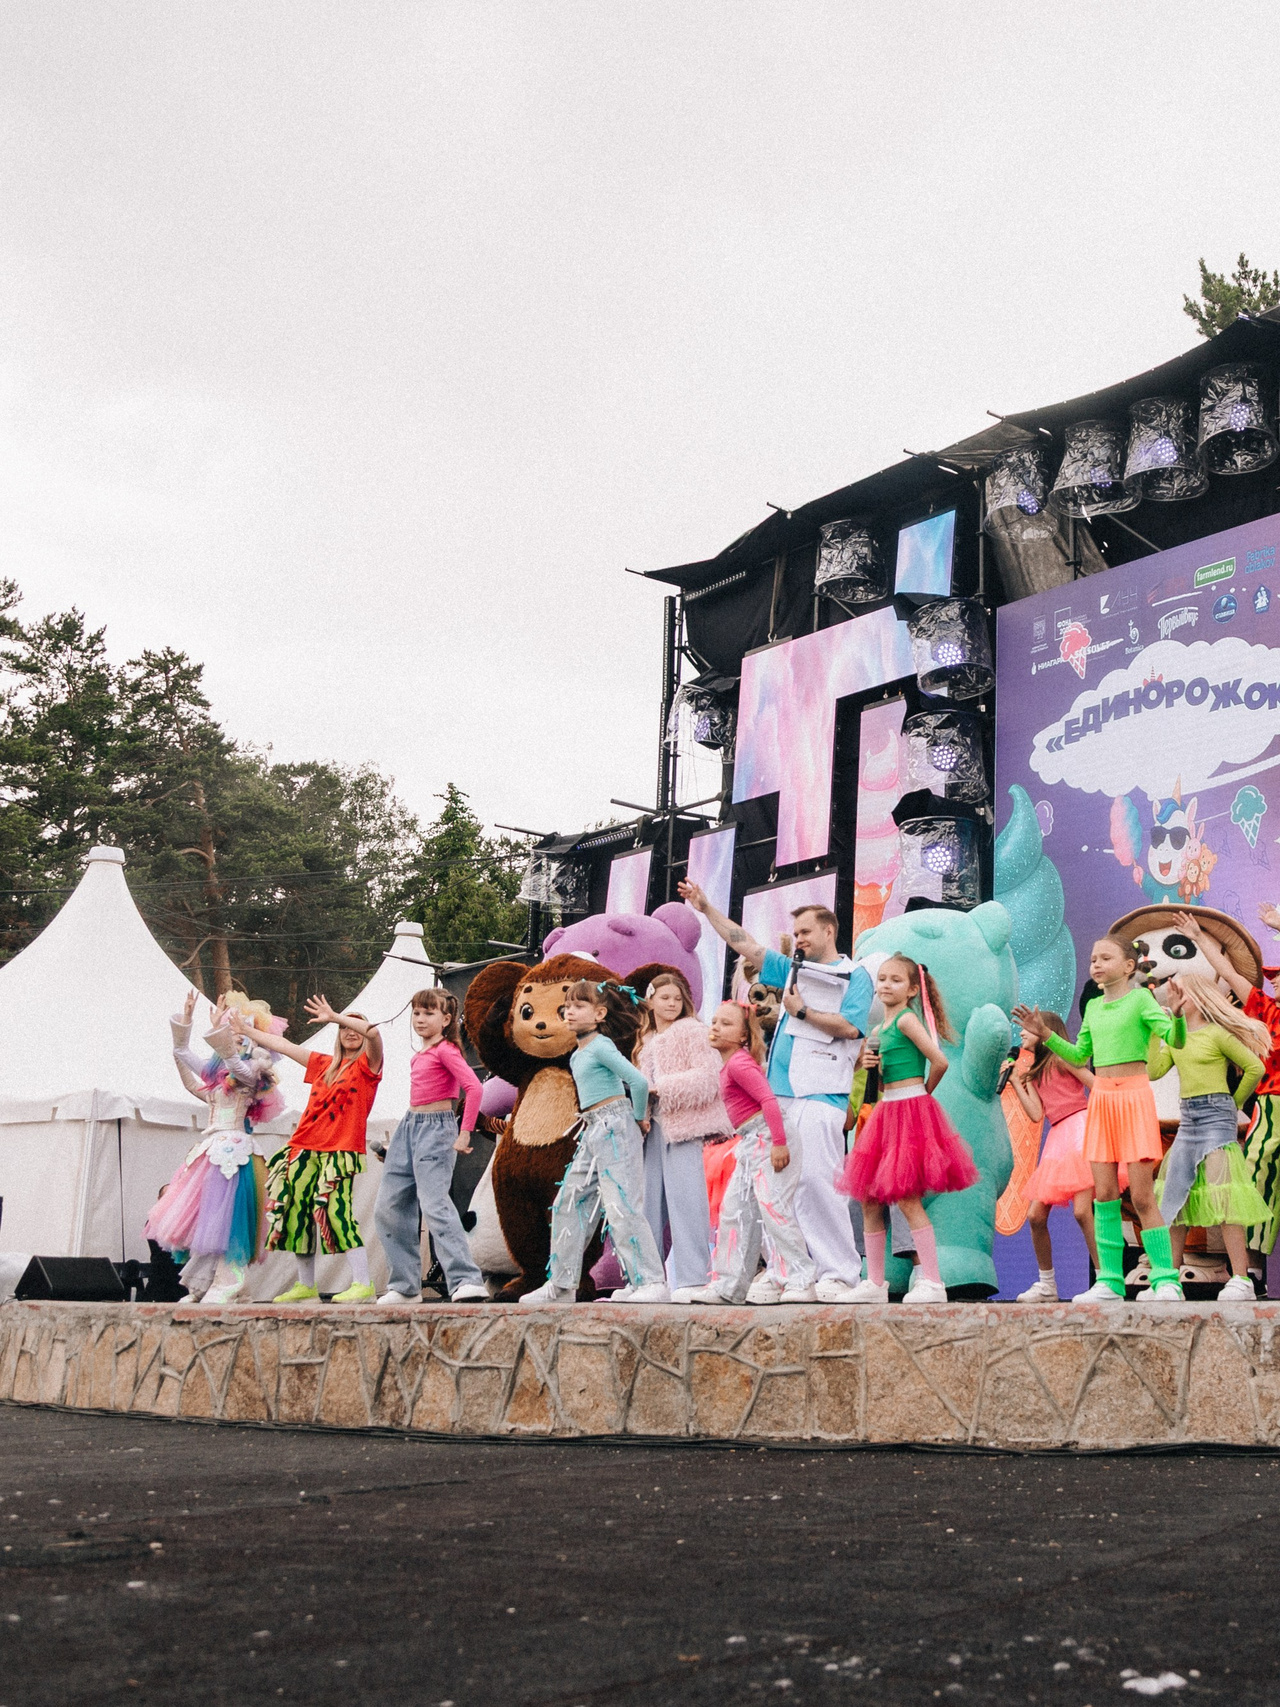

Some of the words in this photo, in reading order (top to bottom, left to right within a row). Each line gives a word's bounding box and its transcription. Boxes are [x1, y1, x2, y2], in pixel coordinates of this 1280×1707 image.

[1246, 546, 1275, 562] Fabrika
[1196, 564, 1233, 582] farmlend.ru
[1244, 558, 1275, 574] oblakov
